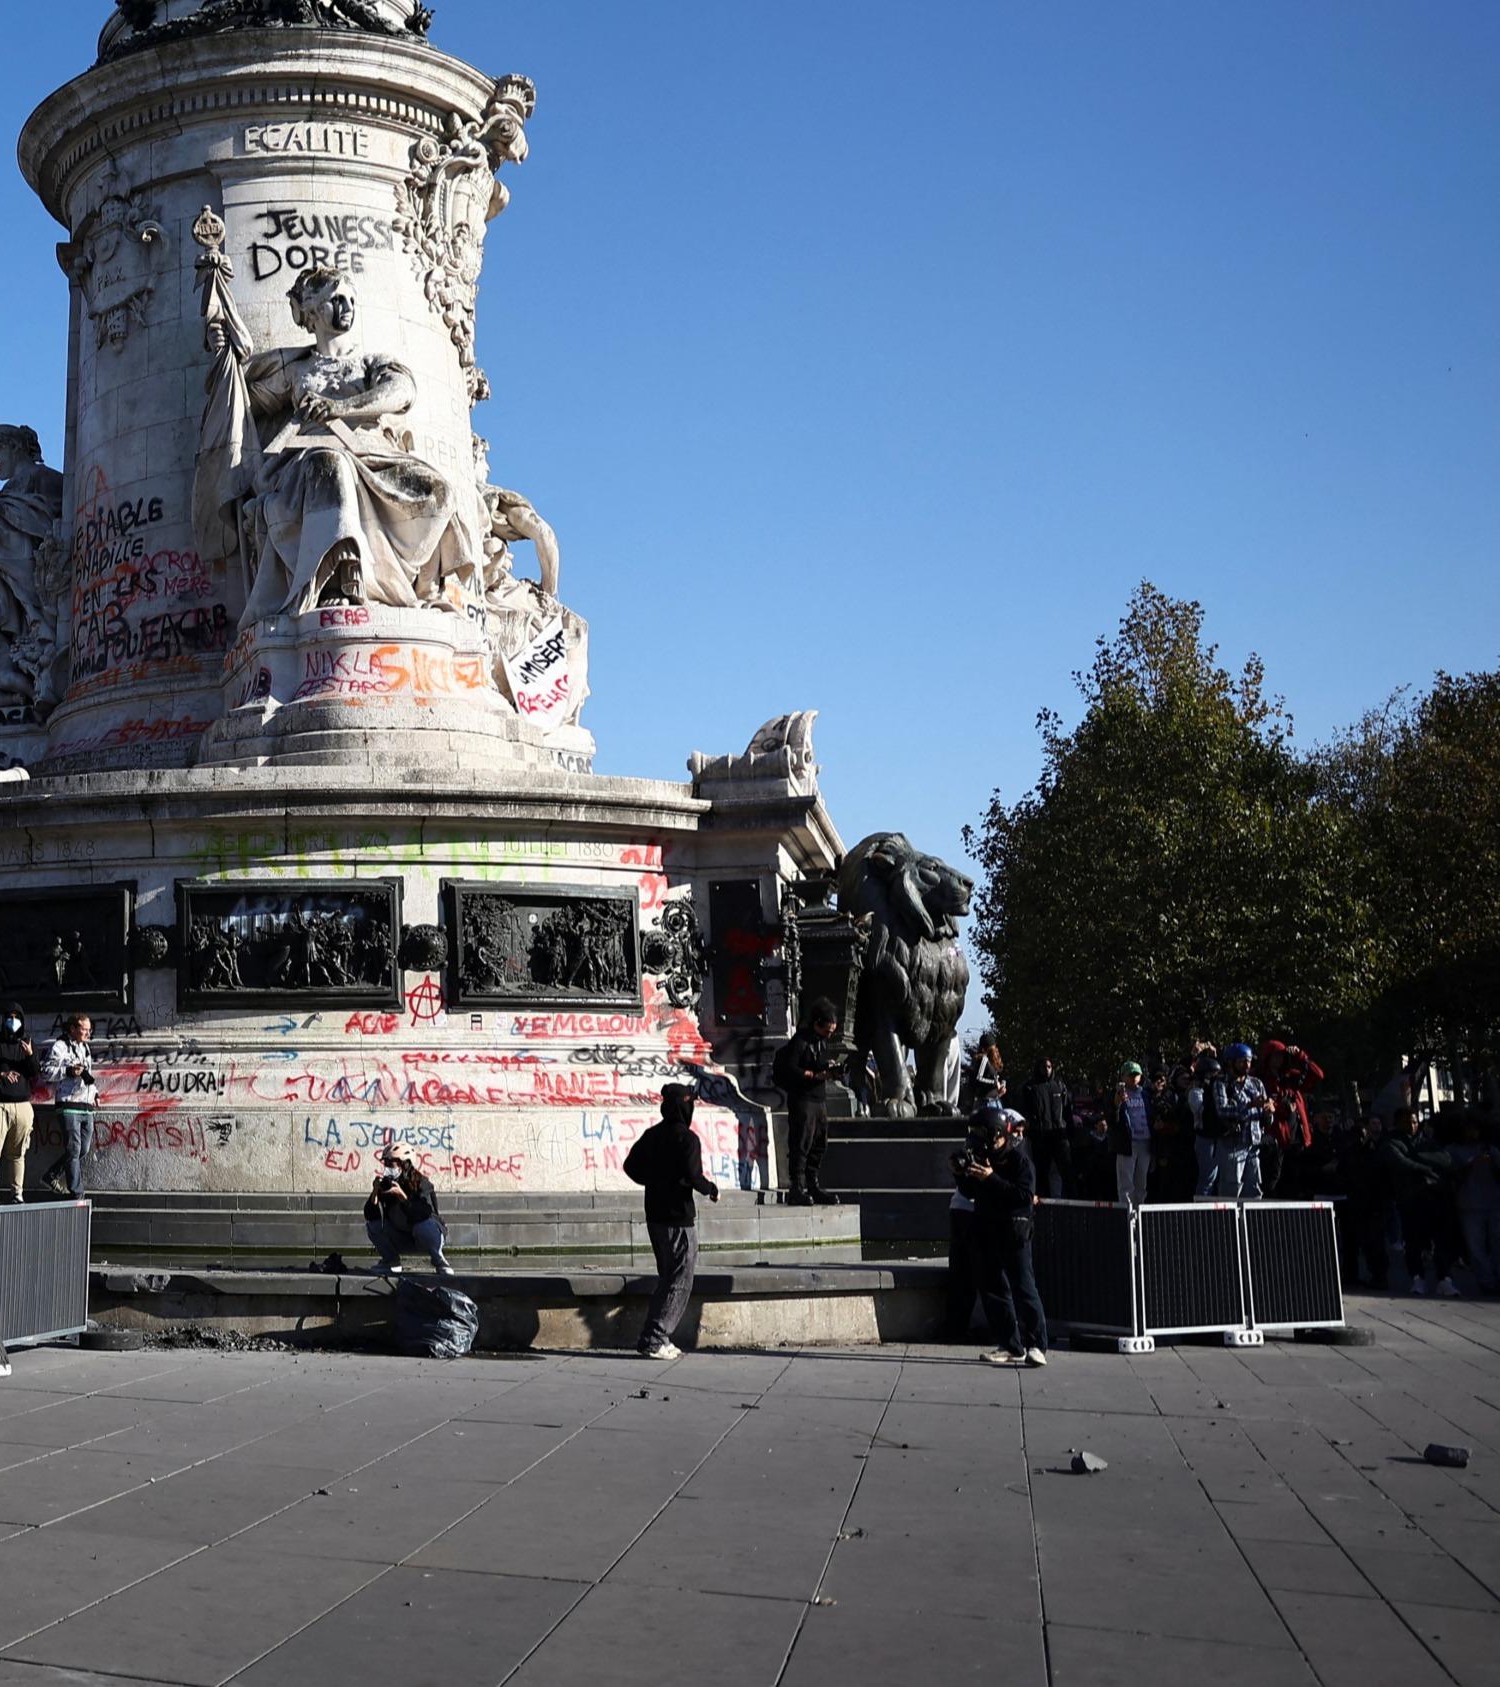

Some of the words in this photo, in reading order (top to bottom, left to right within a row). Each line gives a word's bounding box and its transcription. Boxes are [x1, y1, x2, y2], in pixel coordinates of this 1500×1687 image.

[319, 607, 370, 627] ACAB
[304, 1116, 341, 1147] LA
[581, 1111, 614, 1143] LA
[324, 1151, 361, 1172] EN
